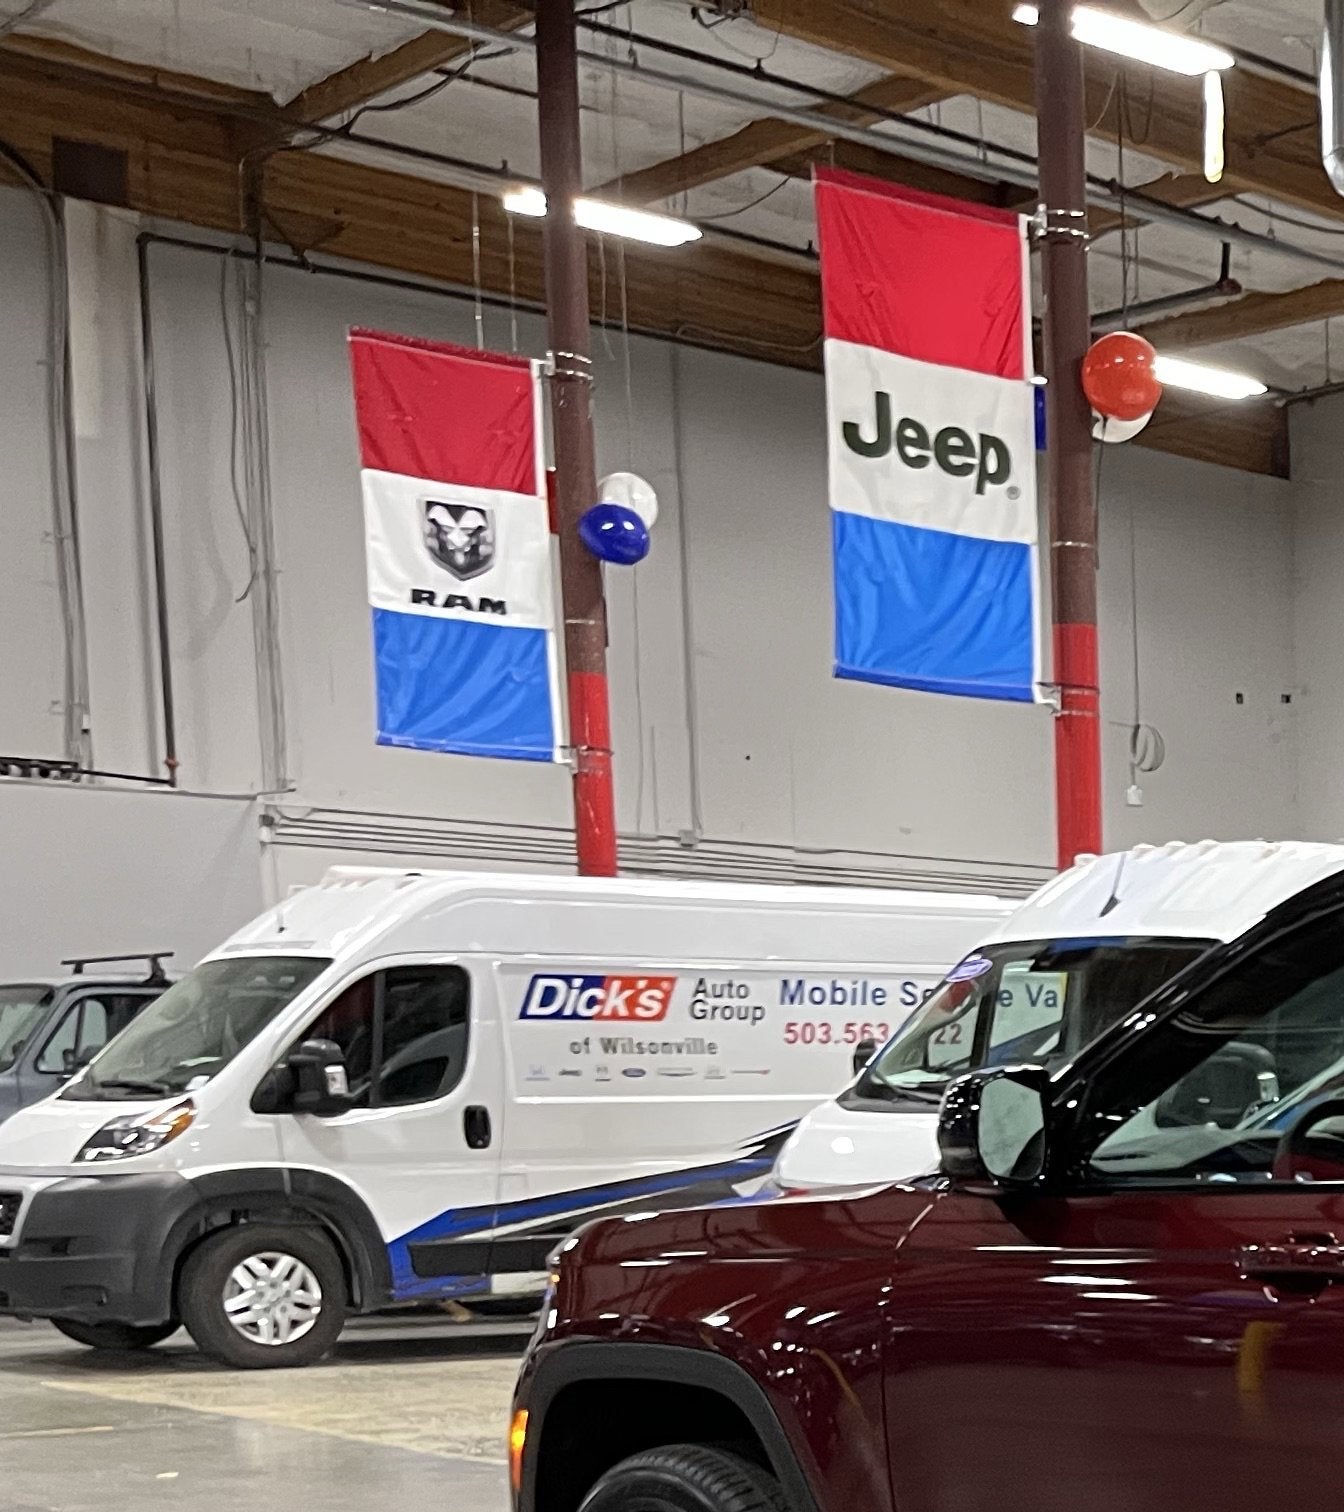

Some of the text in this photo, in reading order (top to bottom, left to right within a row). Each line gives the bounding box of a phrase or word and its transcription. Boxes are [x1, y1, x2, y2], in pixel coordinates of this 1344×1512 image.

[842, 390, 1011, 496] Jeep
[411, 588, 507, 615] RAM
[525, 977, 667, 1019] Dick's
[693, 977, 750, 999] Auto
[779, 979, 887, 1006] Mobile
[690, 999, 766, 1026] Group
[569, 1036, 719, 1055] of Wilsonville
